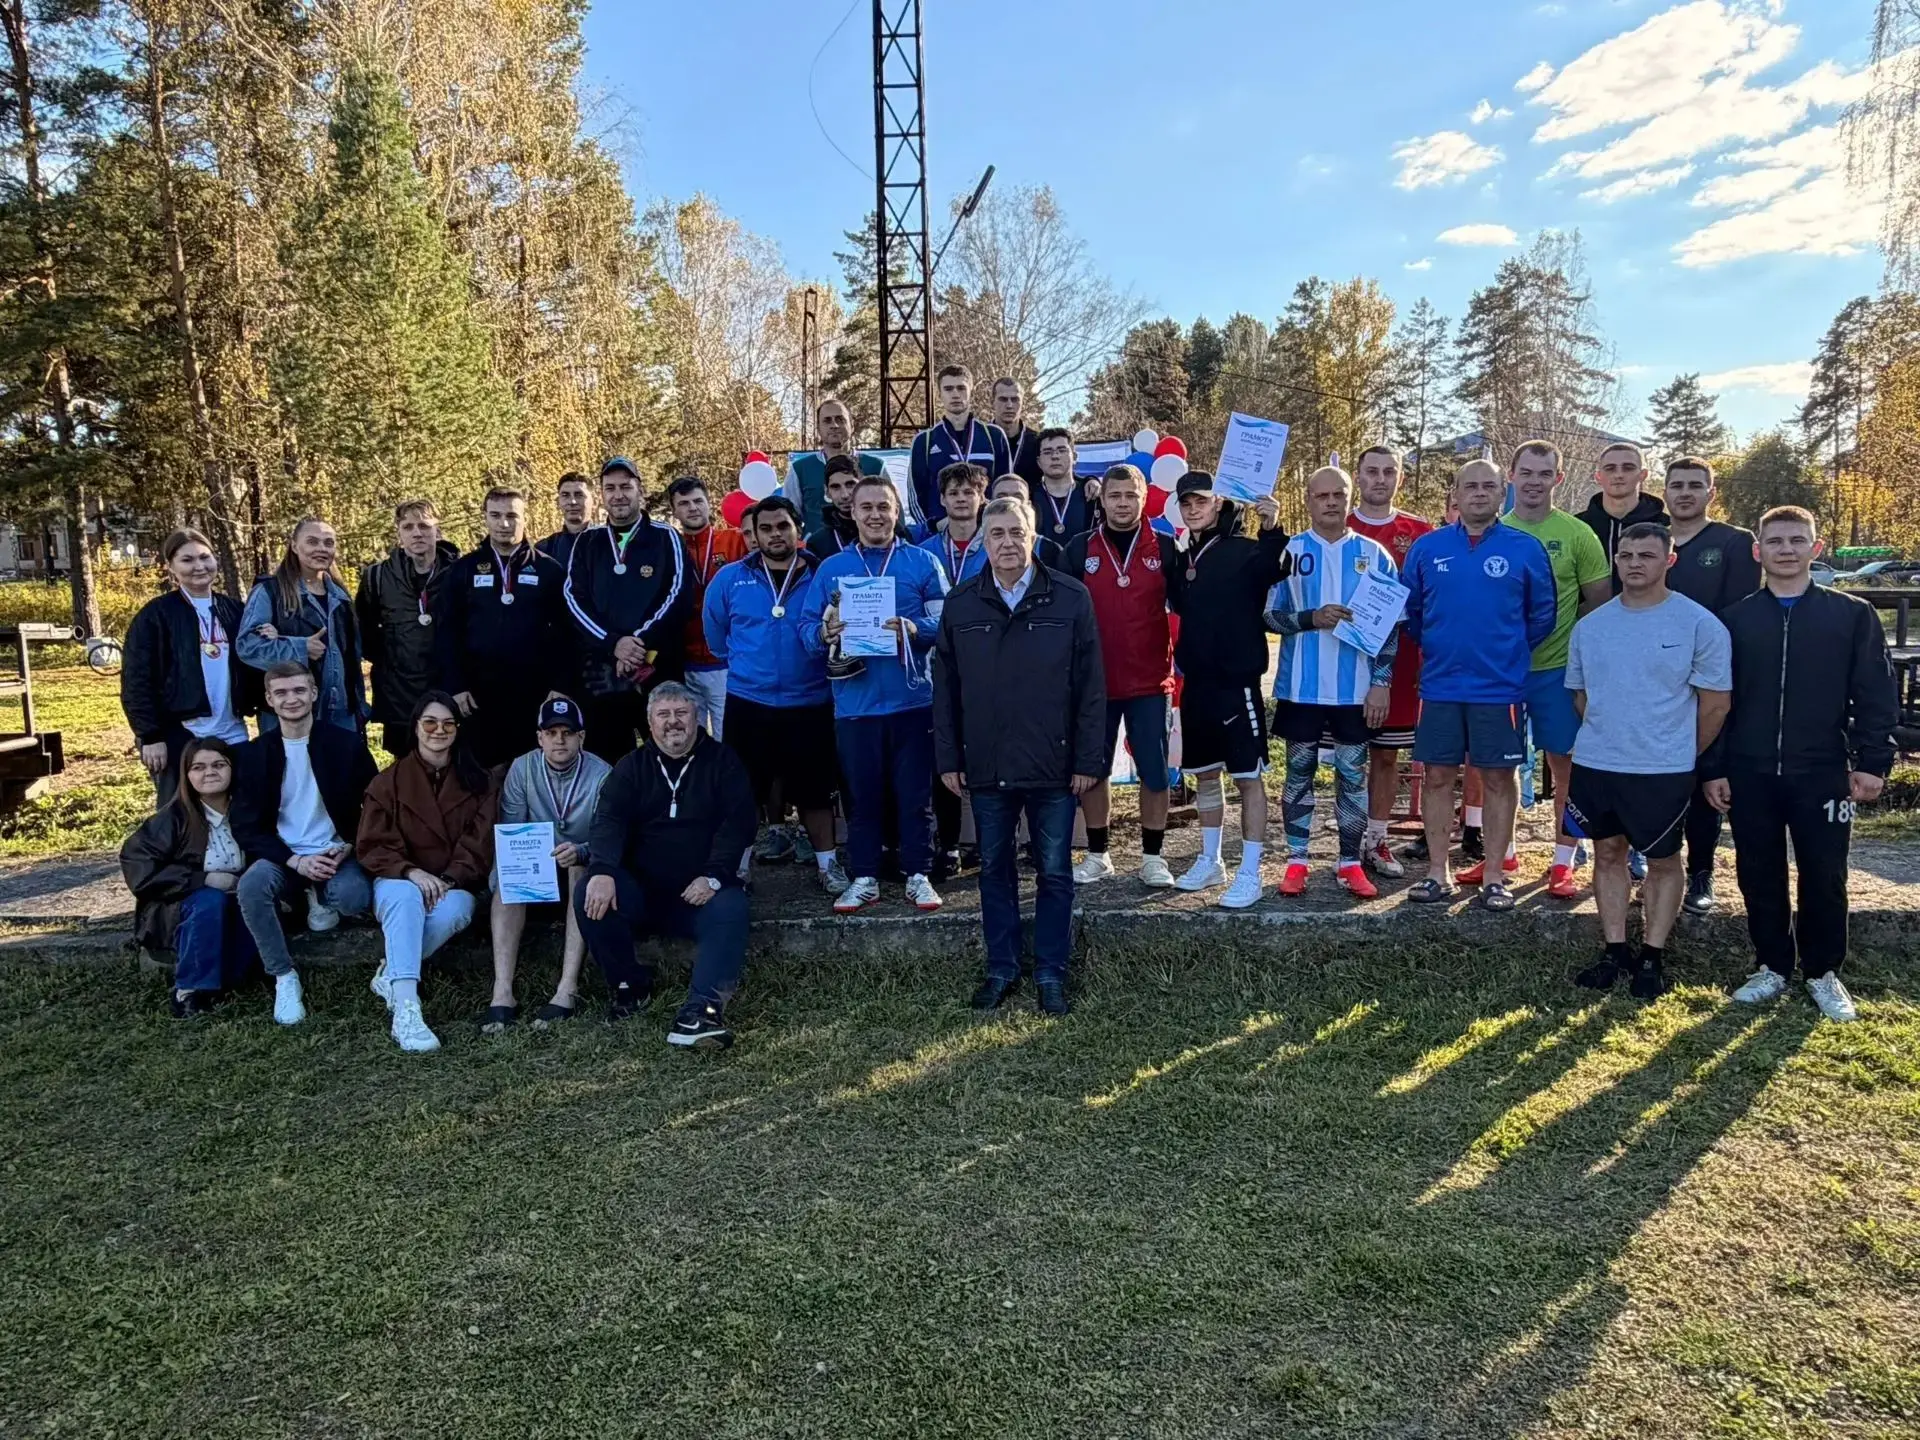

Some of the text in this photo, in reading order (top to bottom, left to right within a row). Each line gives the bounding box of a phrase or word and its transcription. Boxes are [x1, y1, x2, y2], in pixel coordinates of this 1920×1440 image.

[1240, 431, 1273, 445] ГРАМОТА
[1293, 552, 1315, 577] 10
[509, 839, 542, 847] ГРАМОТА
